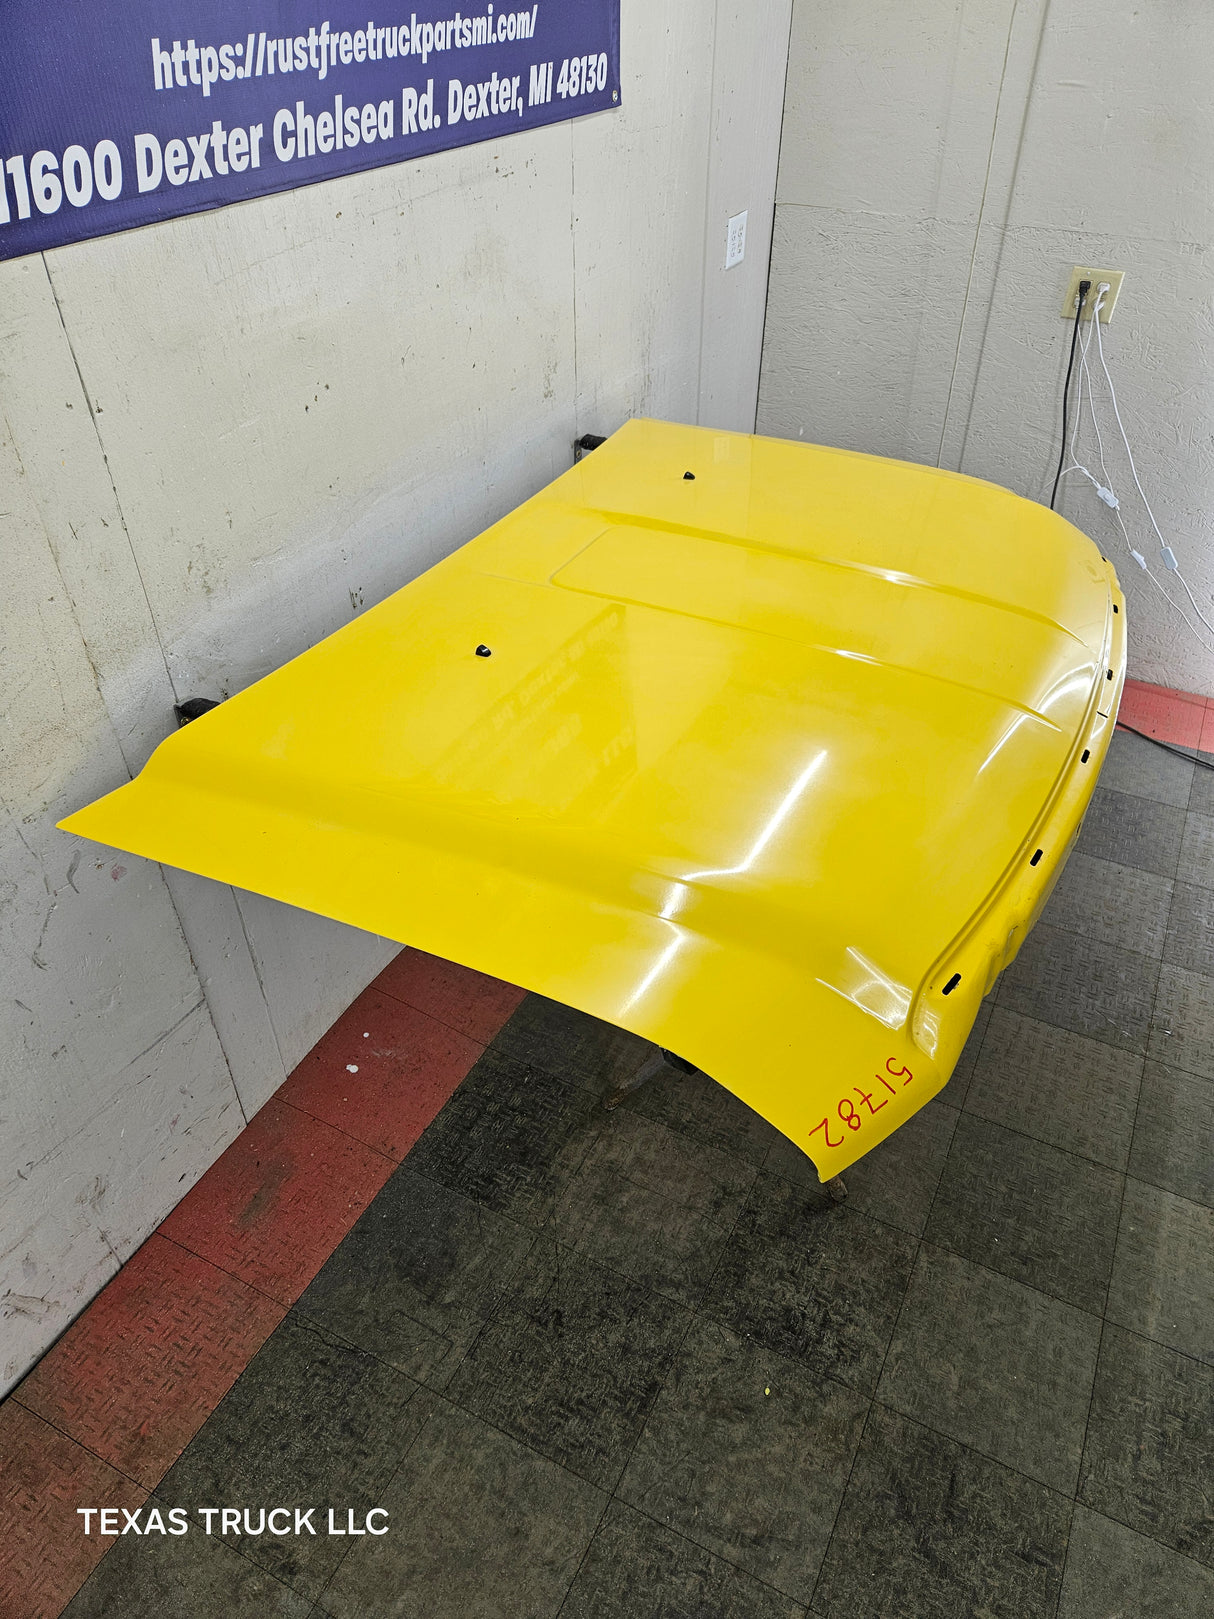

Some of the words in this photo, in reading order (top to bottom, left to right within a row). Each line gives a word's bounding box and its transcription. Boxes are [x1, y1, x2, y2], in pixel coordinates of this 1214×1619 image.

[151, 4, 538, 97] https://rustfreetruckpartsmi.com/
[134, 120, 264, 194] Dexter
[273, 94, 394, 163] Chelsea
[402, 78, 441, 136] Rd.
[447, 71, 523, 126] Dexter,
[528, 62, 554, 107] MI
[556, 52, 608, 99] 48130
[808, 1057, 913, 1148] 51782
